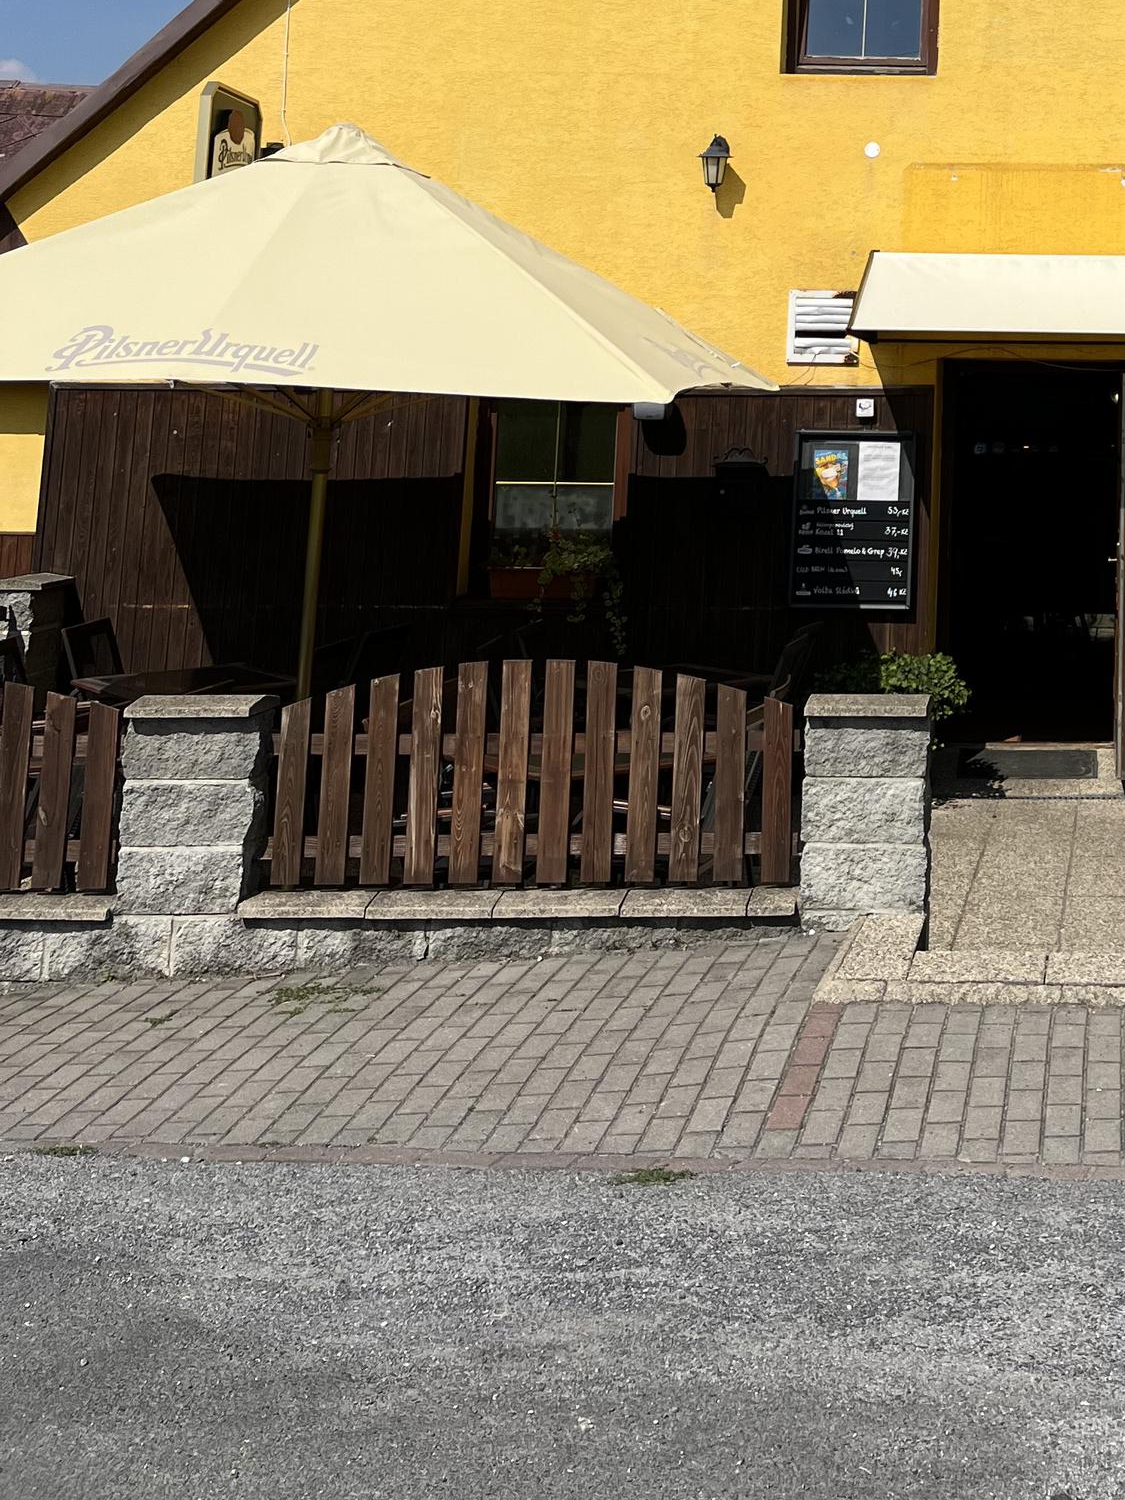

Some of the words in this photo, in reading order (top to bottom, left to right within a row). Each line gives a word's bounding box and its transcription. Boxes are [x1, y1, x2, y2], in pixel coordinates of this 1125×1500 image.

[218, 139, 243, 171] Pilsner
[45, 324, 198, 373] Pilsner
[191, 327, 319, 376] Urquell
[842, 506, 867, 518] Urquell
